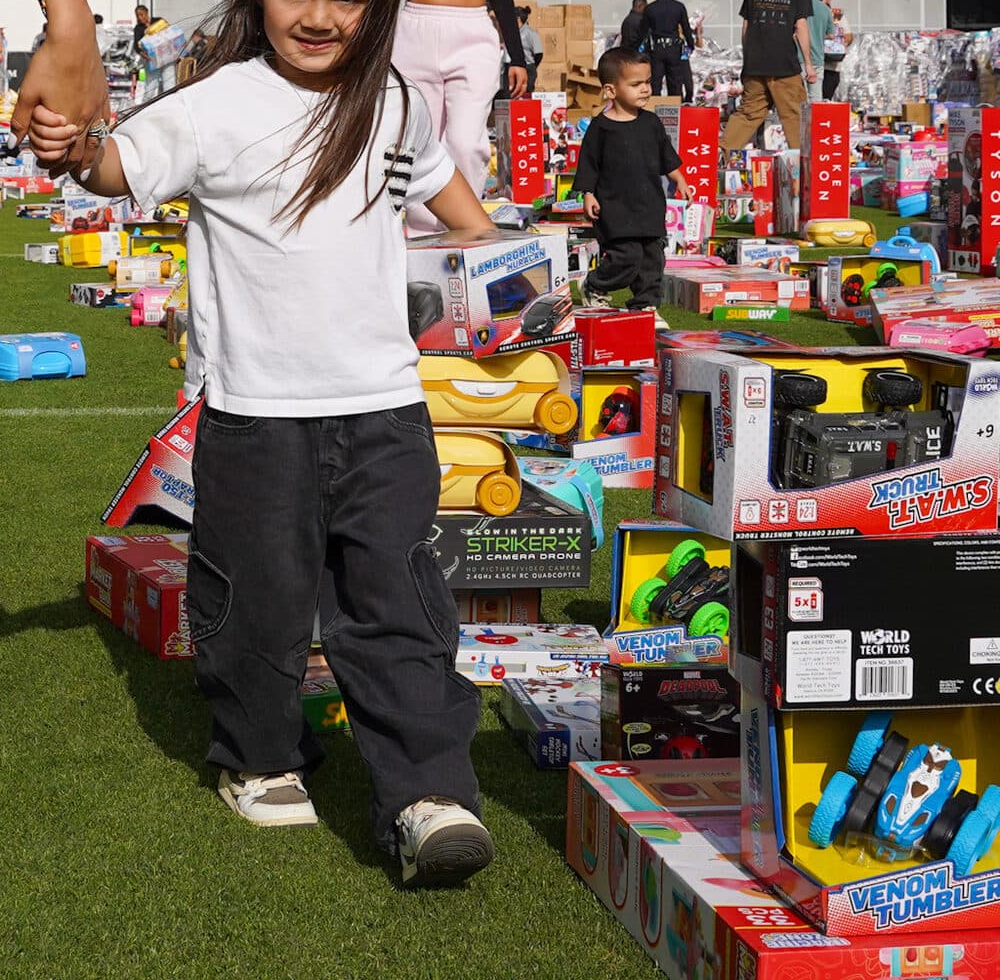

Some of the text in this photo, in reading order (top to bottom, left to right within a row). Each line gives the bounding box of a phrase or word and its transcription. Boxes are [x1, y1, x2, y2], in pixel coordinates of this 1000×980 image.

[516, 116, 528, 186] TYSON
[527, 127, 538, 173] MIKE
[818, 120, 832, 201] TYSON
[831, 134, 842, 187] MIKE
[686, 128, 700, 197] TYSO
[698, 144, 712, 204] MIKE
[471, 239, 541, 278] LAMBORGHINI
[506, 248, 546, 271] HURACAN
[554, 276, 566, 288] 6+
[726, 309, 776, 320] SUBWAY
[847, 440, 882, 452] S.W.A.T.
[926, 426, 941, 459] ICE
[594, 459, 653, 475] TUMBLER
[152, 467, 196, 496] RAPTOR
[876, 472, 941, 502] TRUCK
[891, 480, 991, 523] S.W.A.T.
[467, 536, 581, 553] STRIKER-X
[735, 529, 855, 540] REMOTE CONTROL MONSTER TRUCK
[487, 553, 536, 561] CAMERA
[616, 632, 681, 651] VENOM
[860, 629, 910, 645] WORLD
[860, 645, 884, 655] TECH
[886, 644, 910, 655] TOYS
[625, 683, 641, 693] 6+
[658, 679, 728, 697] DEADPOOL
[851, 869, 947, 911] VENOM
[874, 882, 1000, 927] TUMBLER
[746, 915, 796, 926] 33
